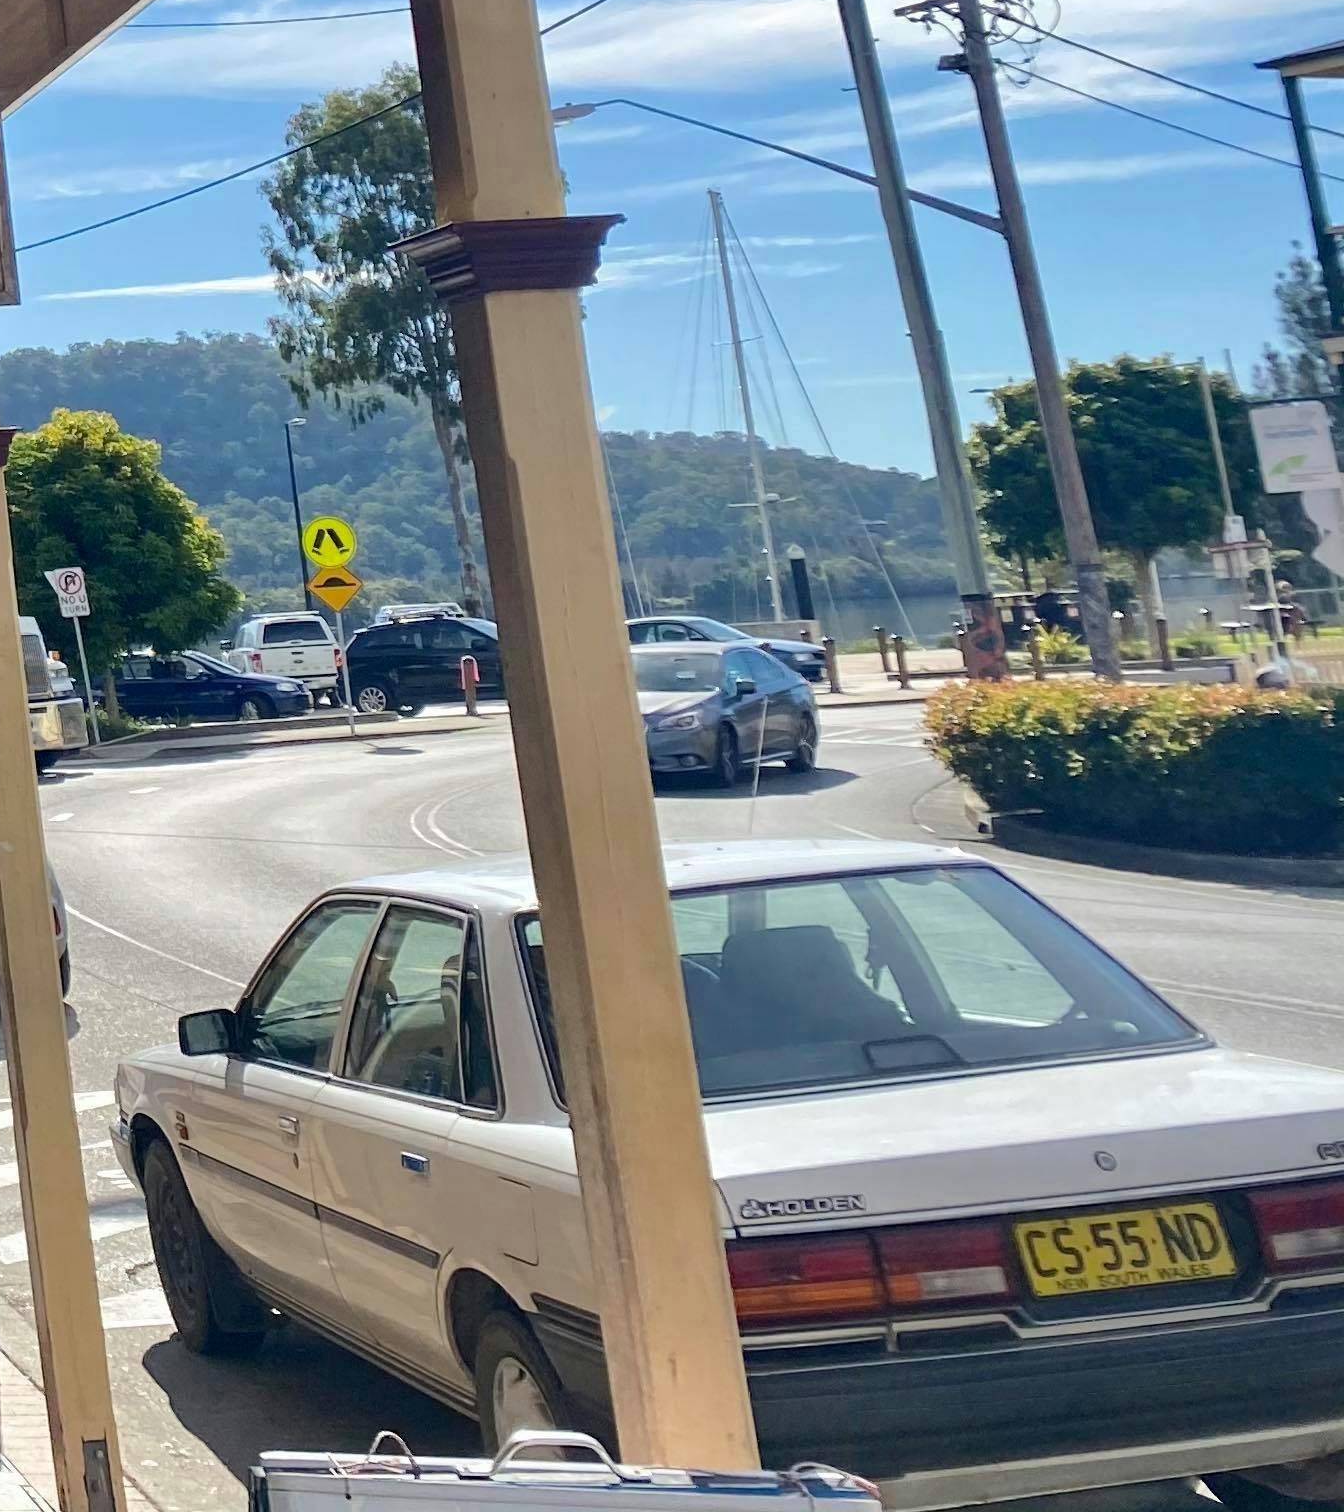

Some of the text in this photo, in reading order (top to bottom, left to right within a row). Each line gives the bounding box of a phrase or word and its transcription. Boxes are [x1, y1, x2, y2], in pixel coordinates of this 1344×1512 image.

[61, 594, 86, 604] NO U
[63, 605, 87, 614] TURN
[766, 1194, 866, 1217] HOLDEN
[1056, 1264, 1212, 1291] NEW SOUTH WALES
